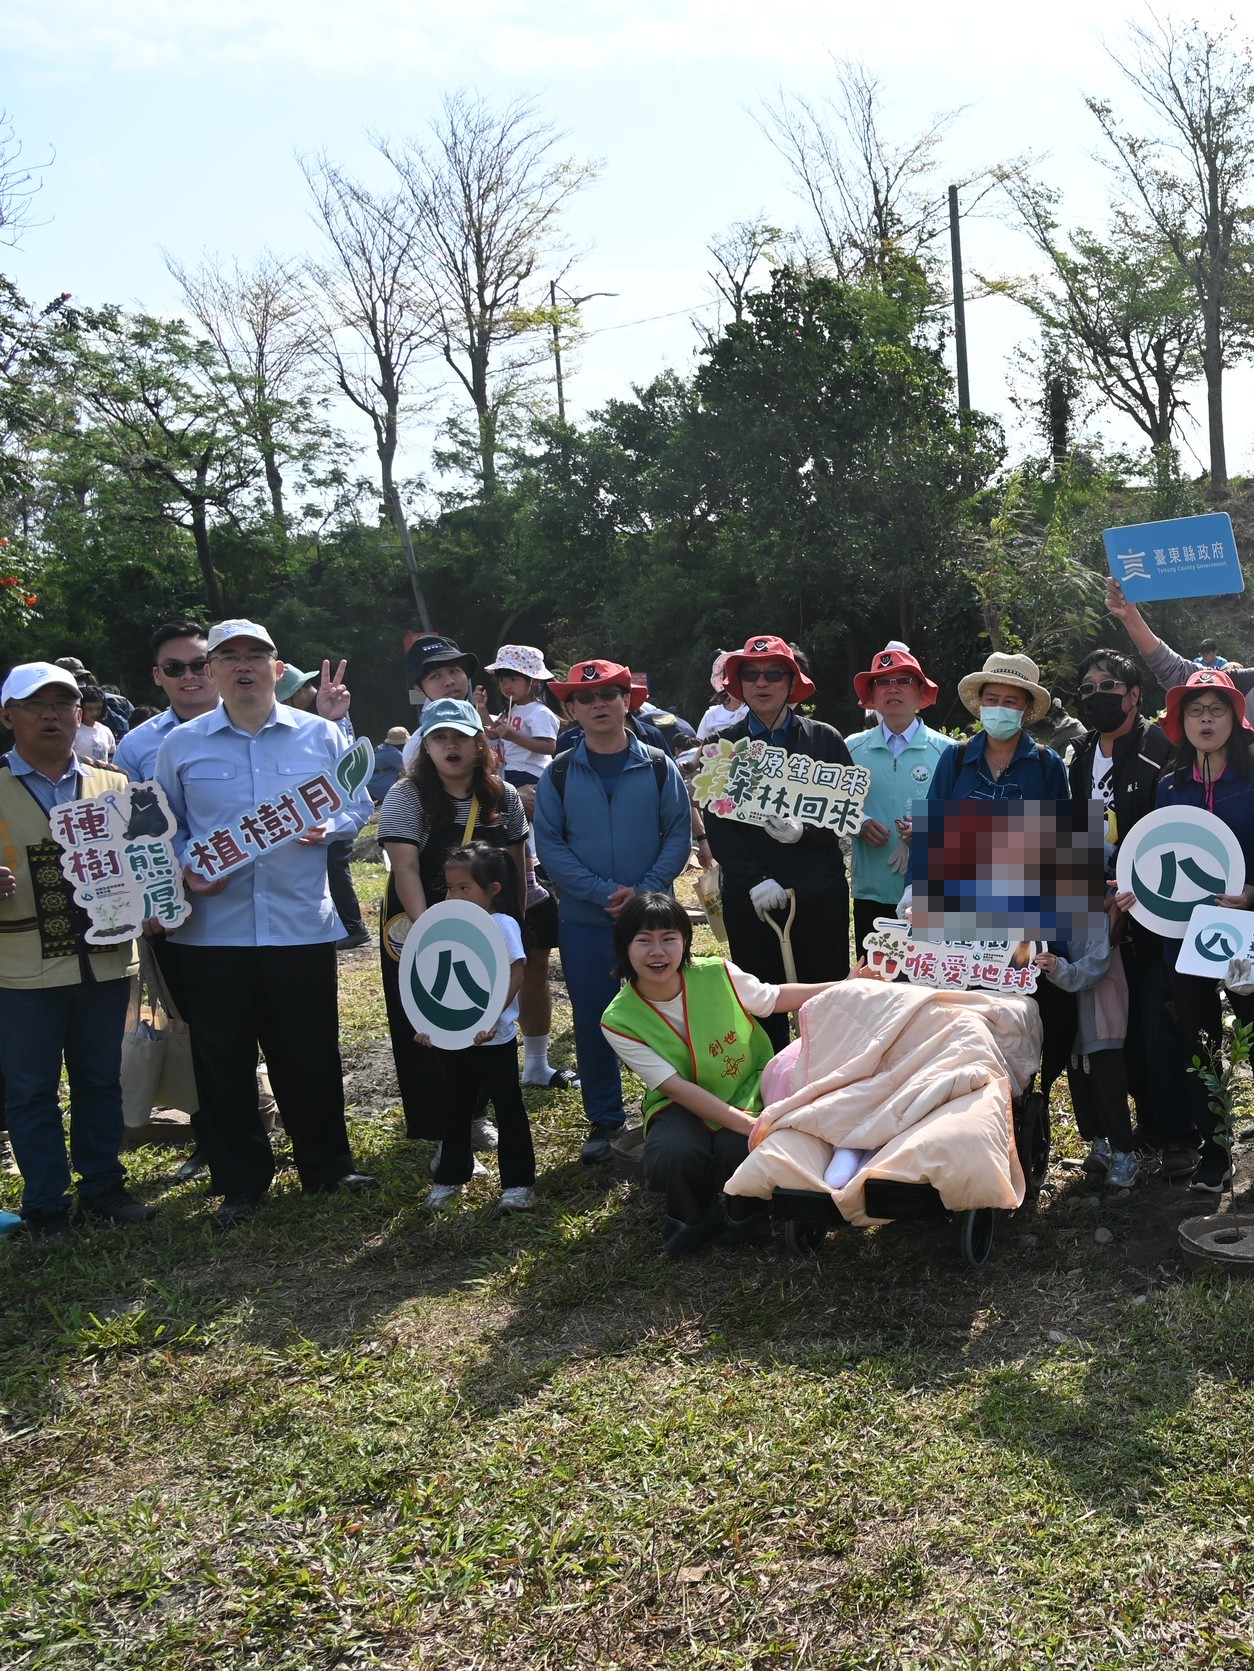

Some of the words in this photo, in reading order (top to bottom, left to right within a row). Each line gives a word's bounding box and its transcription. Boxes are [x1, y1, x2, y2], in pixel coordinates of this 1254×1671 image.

[1153, 541, 1224, 566] 臺東縣政府
[1157, 566, 1177, 574] Taitung
[1177, 563, 1195, 571] County
[1196, 561, 1227, 569] Government
[757, 750, 868, 797] 原生回來
[706, 757, 861, 833] 森林回來
[189, 775, 342, 877] 植樹月
[709, 1030, 737, 1058] 創世
